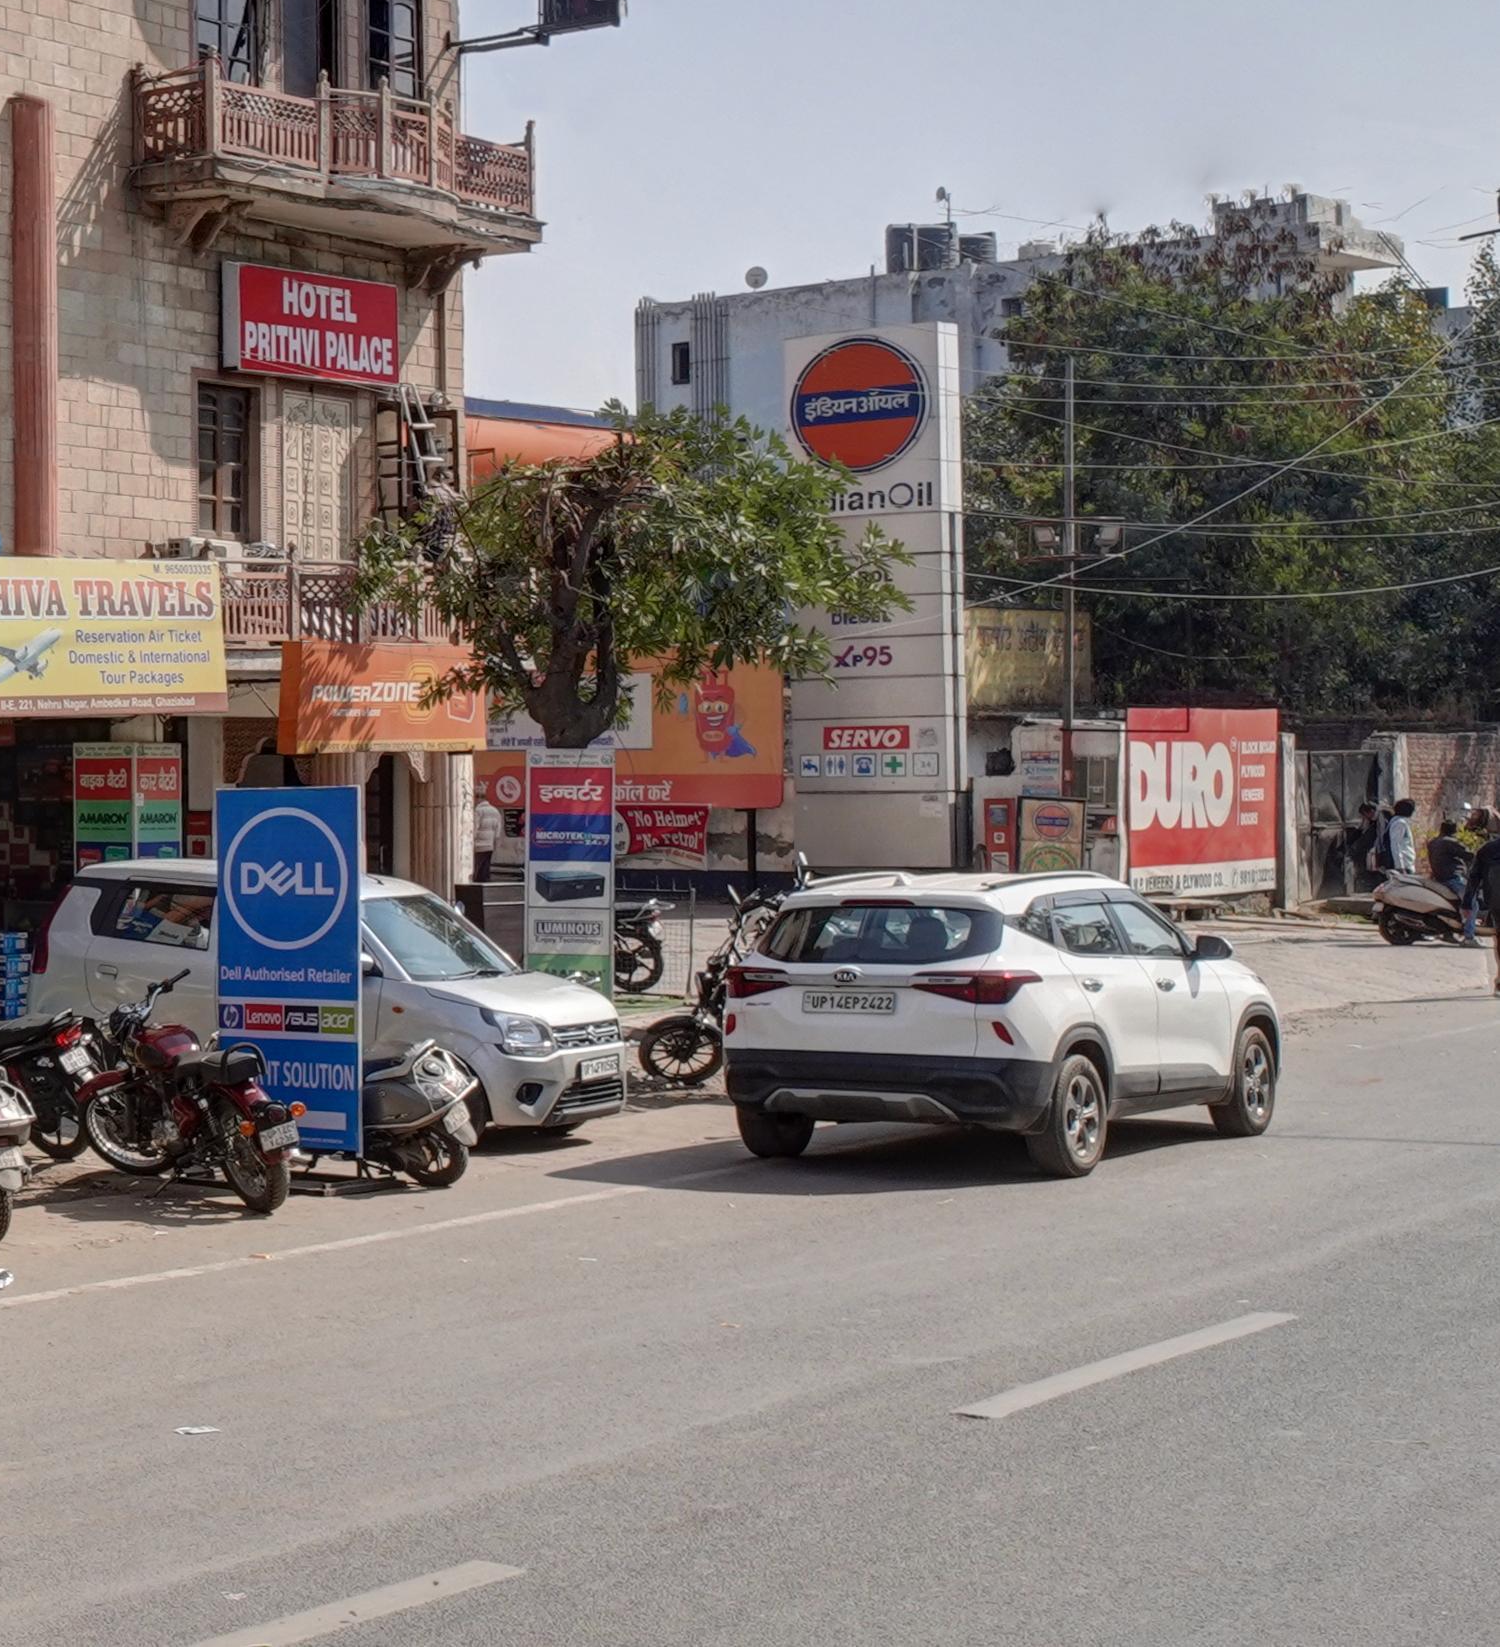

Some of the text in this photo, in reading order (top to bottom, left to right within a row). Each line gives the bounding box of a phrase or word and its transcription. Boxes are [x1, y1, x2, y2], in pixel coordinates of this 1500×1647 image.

[283, 276, 357, 323] HOTEL
[244, 320, 394, 376] PRITHVI PALACE
[73, 579, 214, 618] TRAVELS
[76, 629, 203, 643] Reservation Air Ticket
[69, 650, 211, 664] Domestic & International
[100, 671, 185, 687] Tour Packages
[37, 700, 63, 710] Nehru
[828, 728, 902, 749] SERVO
[1129, 740, 1234, 832] DURO
[78, 812, 127, 825] AMARON
[139, 812, 176, 825] AMARON
[240, 860, 335, 896] DELL
[537, 921, 601, 935] LUMINOUS
[220, 965, 352, 984] Dell Authorised Retailer
[836, 972, 855, 982] KIA
[811, 992, 893, 1011] UP14EP2422
[246, 1007, 282, 1026] Lenovo
[285, 1011, 319, 1026] ASUS
[321, 1013, 353, 1029] acer
[283, 1062, 355, 1091] SOLUTION
